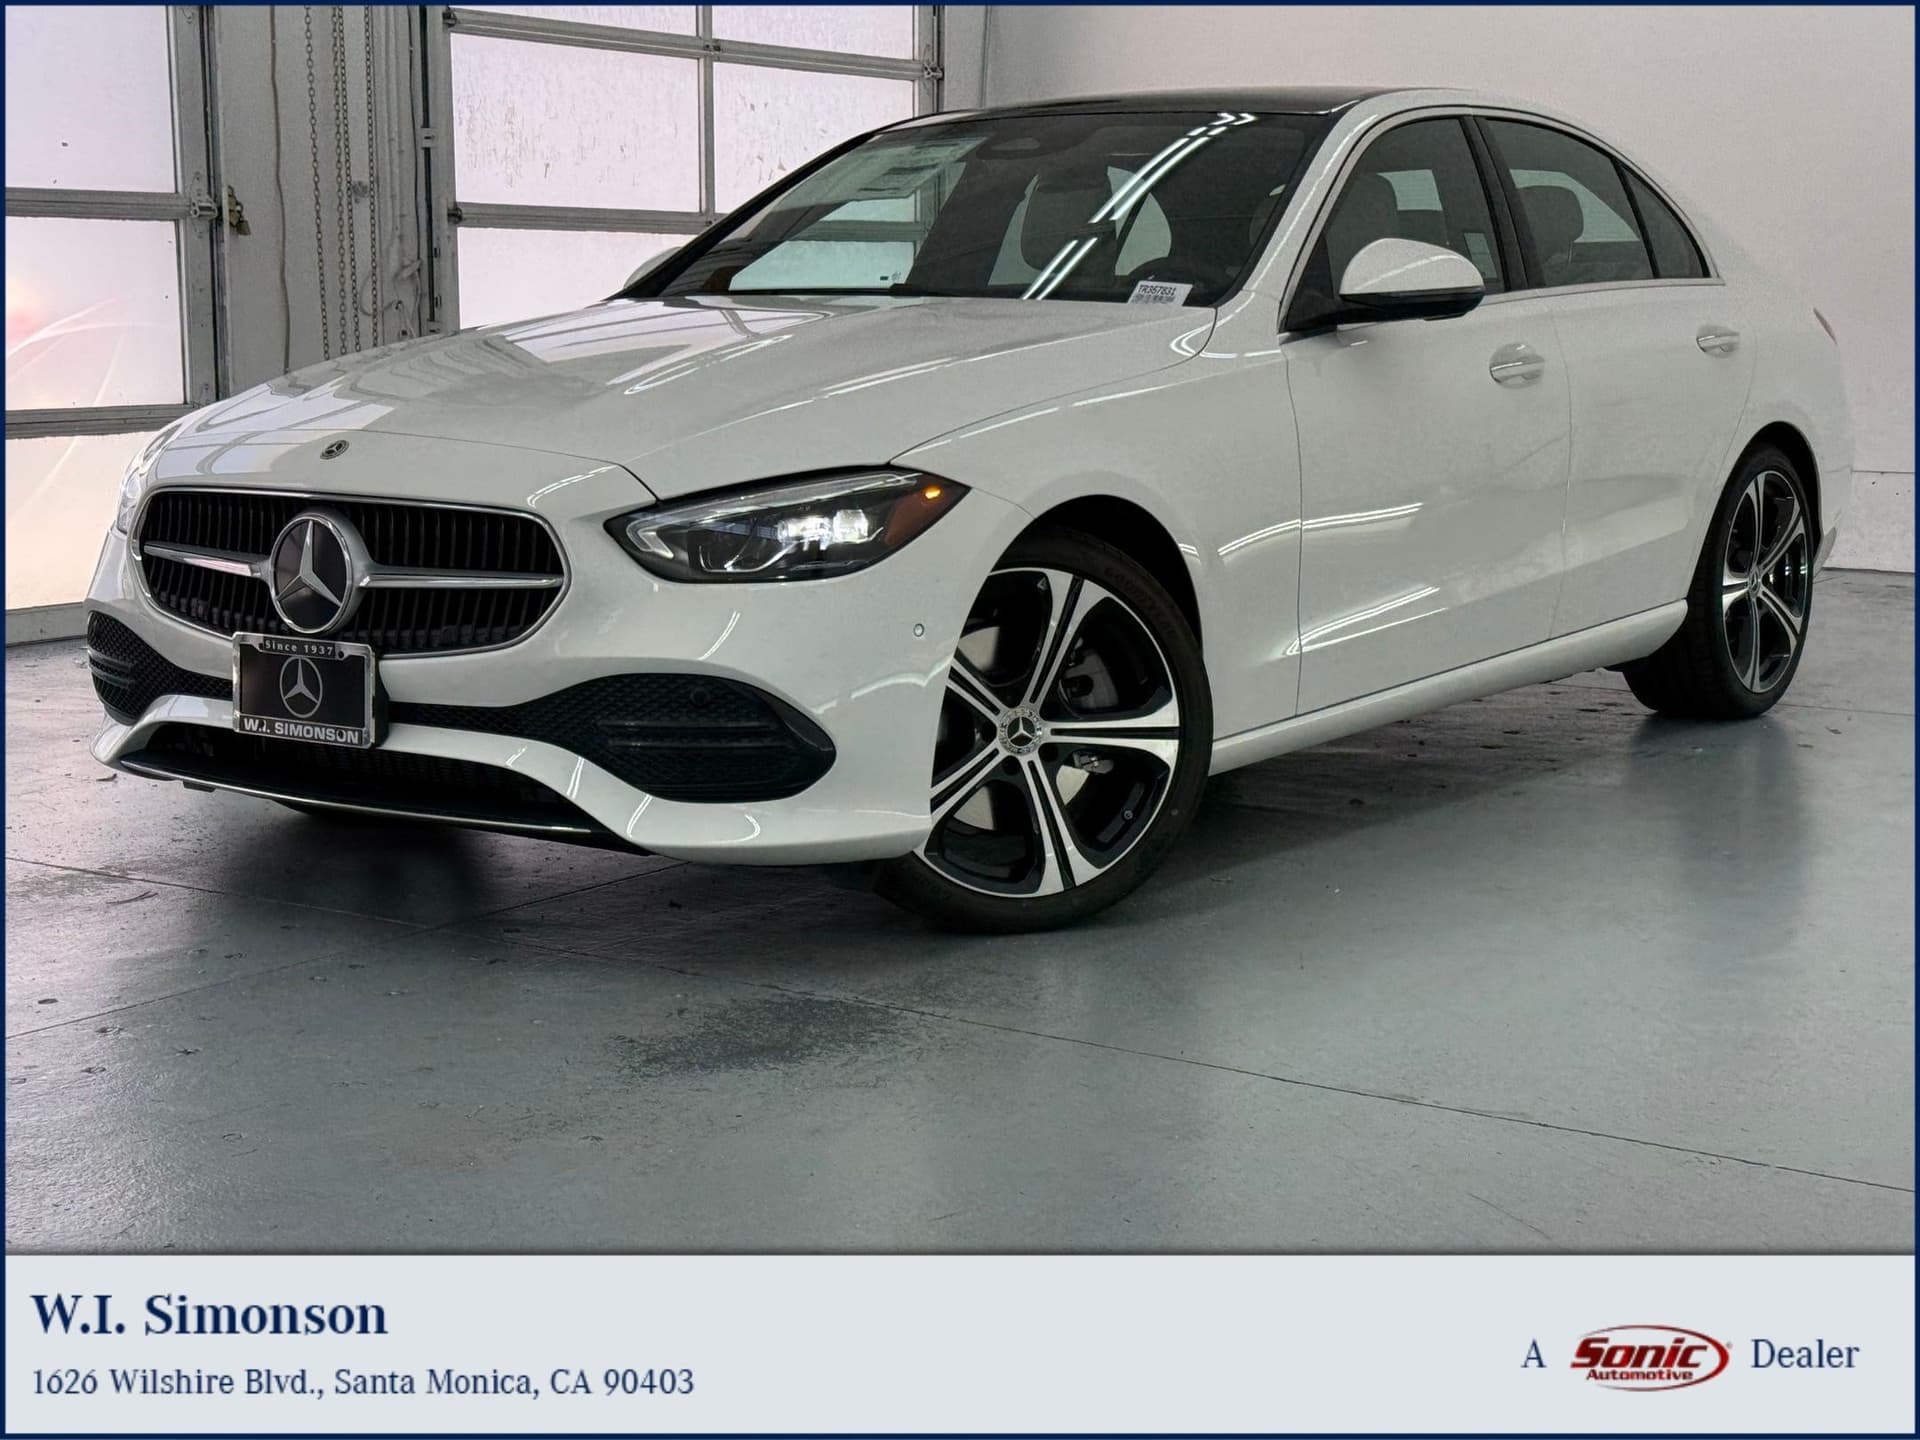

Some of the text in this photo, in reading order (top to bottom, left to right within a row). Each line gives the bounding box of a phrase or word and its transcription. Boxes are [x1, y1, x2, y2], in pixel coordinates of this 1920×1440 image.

[265, 639, 334, 656] Since 1937
[244, 718, 359, 745] W.I. SIMONSON
